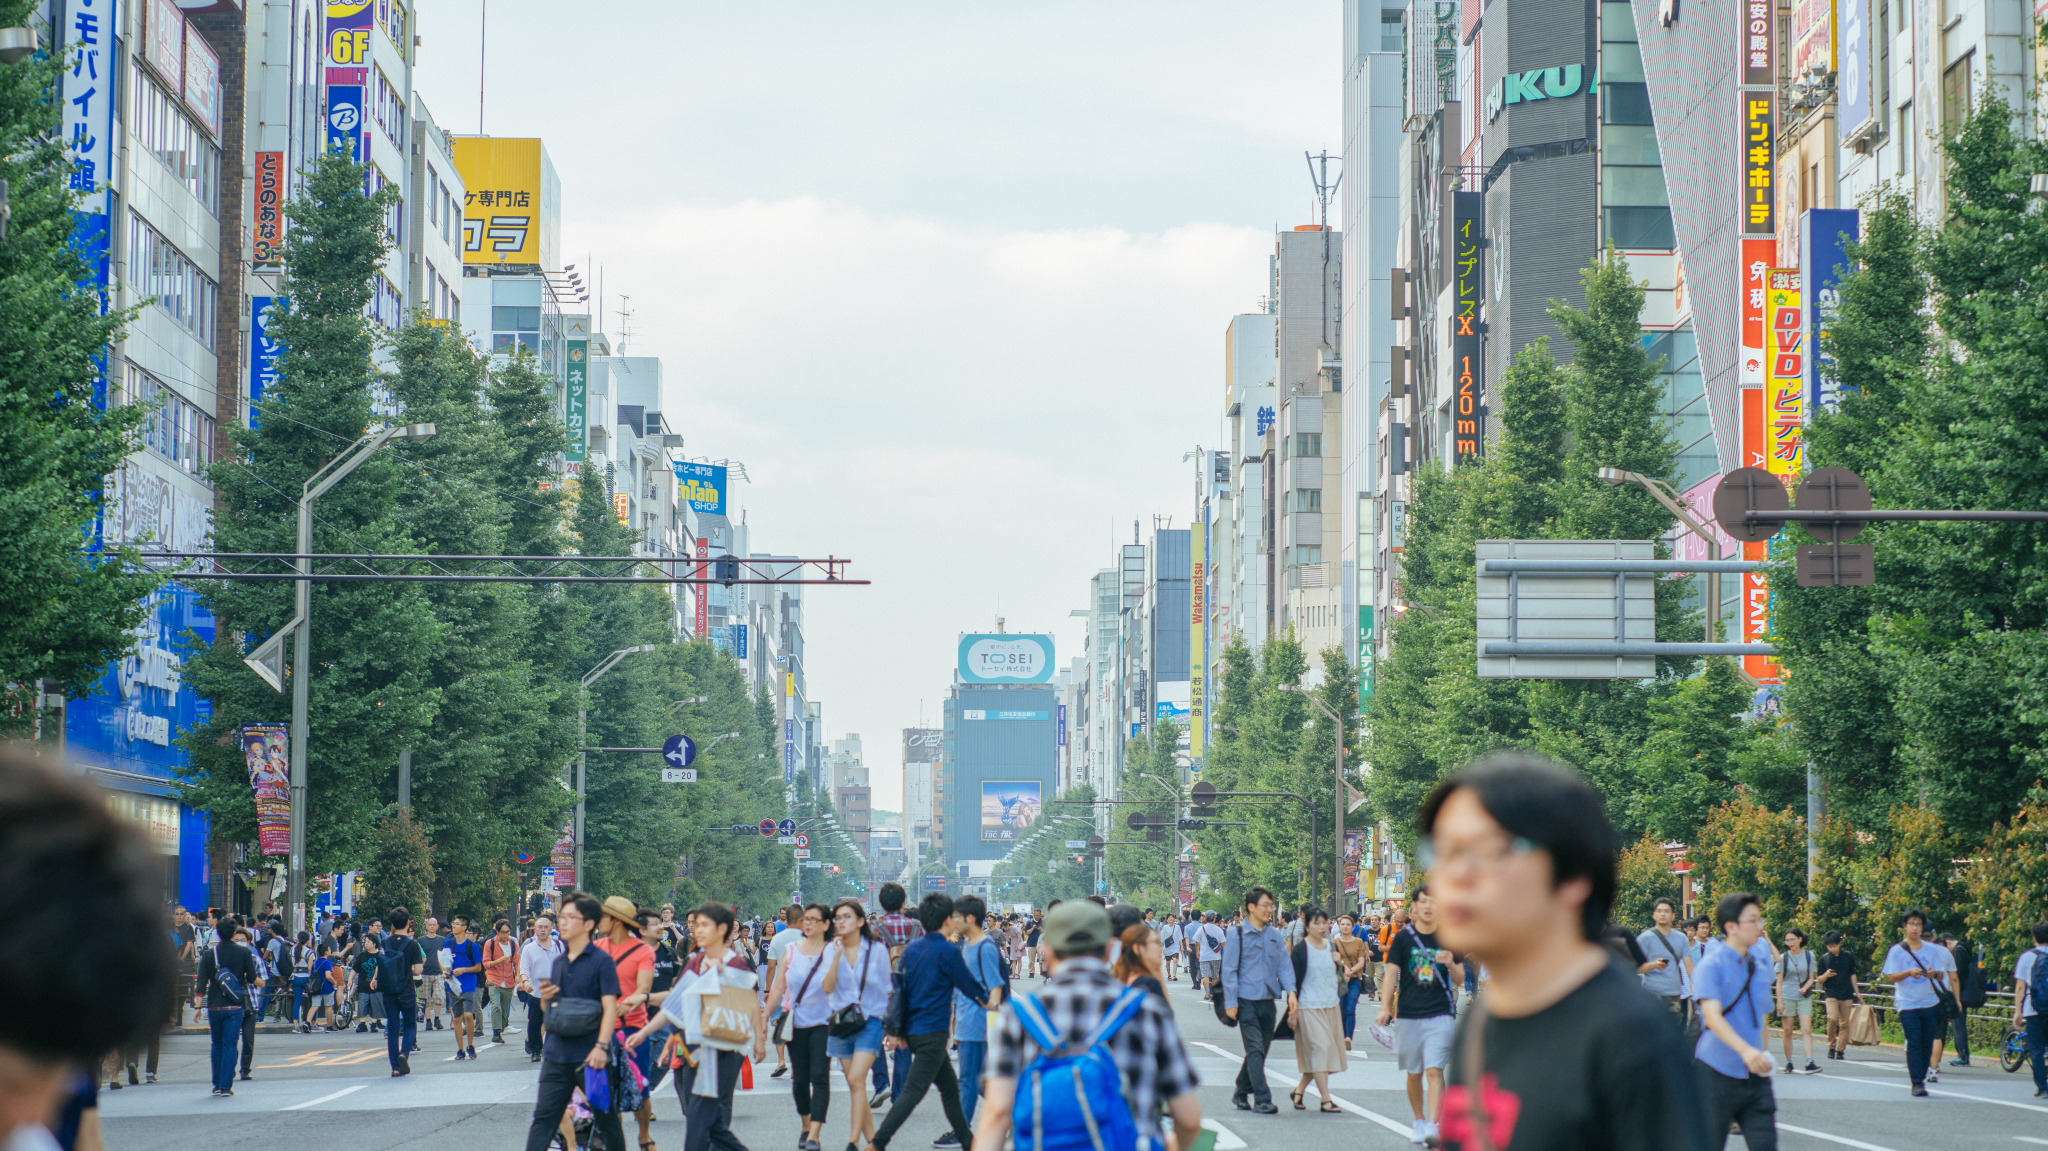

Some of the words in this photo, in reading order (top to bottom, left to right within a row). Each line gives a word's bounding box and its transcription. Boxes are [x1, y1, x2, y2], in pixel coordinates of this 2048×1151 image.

[330, 28, 370, 65] 6F
[1749, 0, 1769, 68] 安の殿堂
[1749, 100, 1770, 225] ドン・キホーテ
[258, 153, 277, 241] とらのあな
[694, 501, 719, 511] SHOP
[1192, 562, 1203, 625] Wakamatsu
[1360, 627, 1372, 691] リバティー
[1191, 676, 1203, 717] 若松通商
